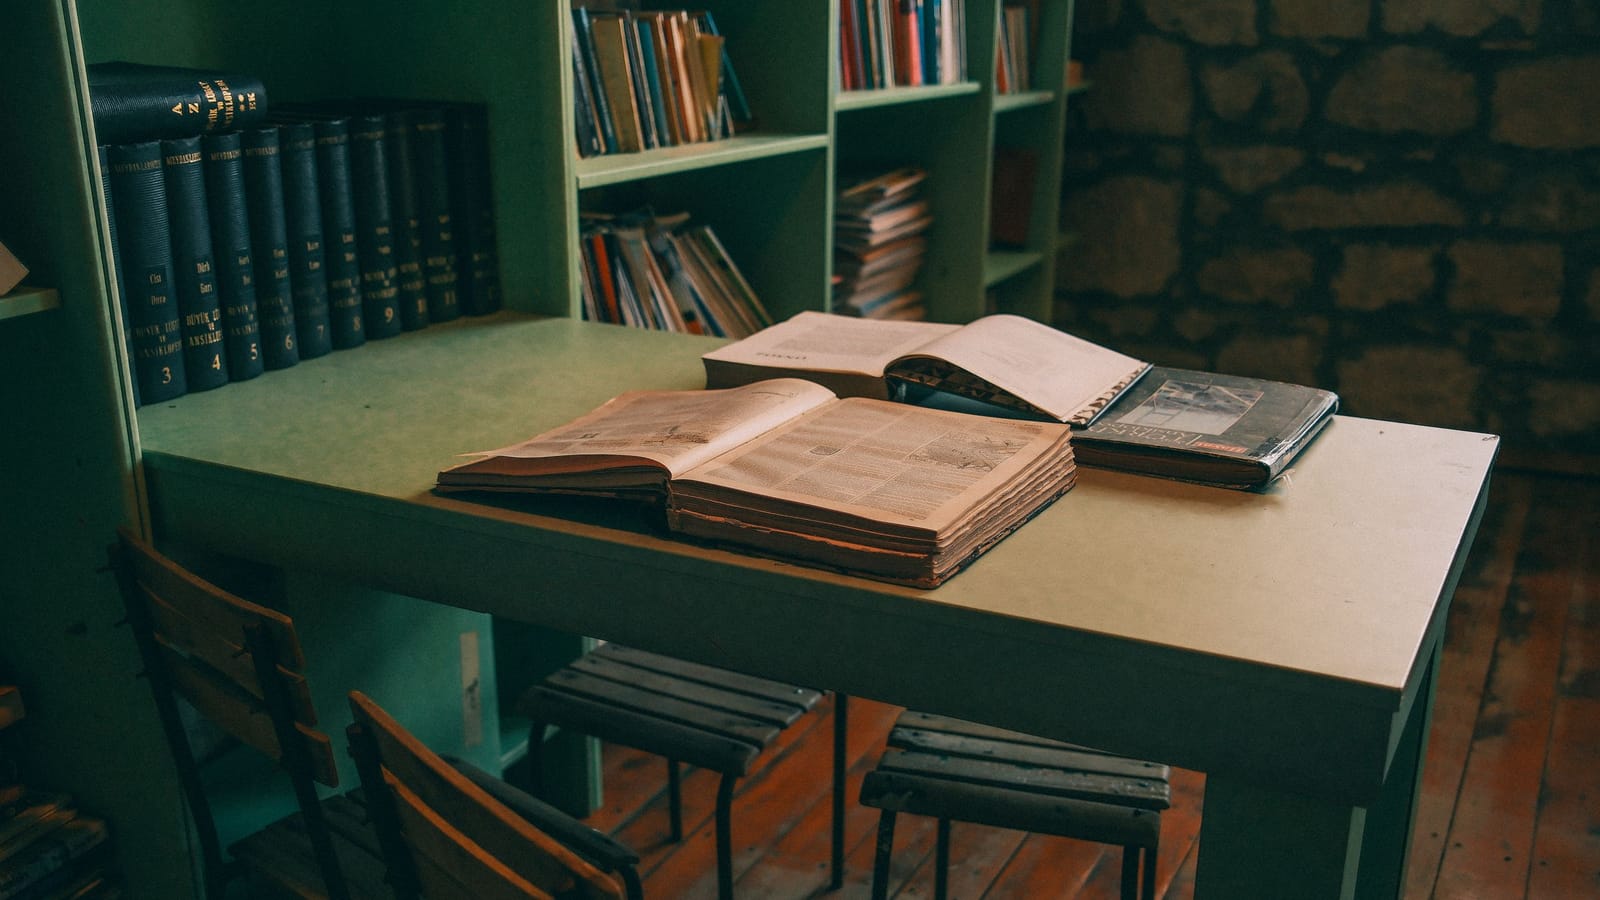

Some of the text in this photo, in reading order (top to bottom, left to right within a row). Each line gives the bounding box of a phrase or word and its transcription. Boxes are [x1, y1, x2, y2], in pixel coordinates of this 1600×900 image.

[171, 102, 183, 116] A
[188, 103, 199, 114] Z
[384, 307, 395, 324] 9
[284, 334, 294, 350] 6
[250, 342, 259, 361] 5
[211, 353, 222, 370] 4
[161, 366, 172, 385] 3
